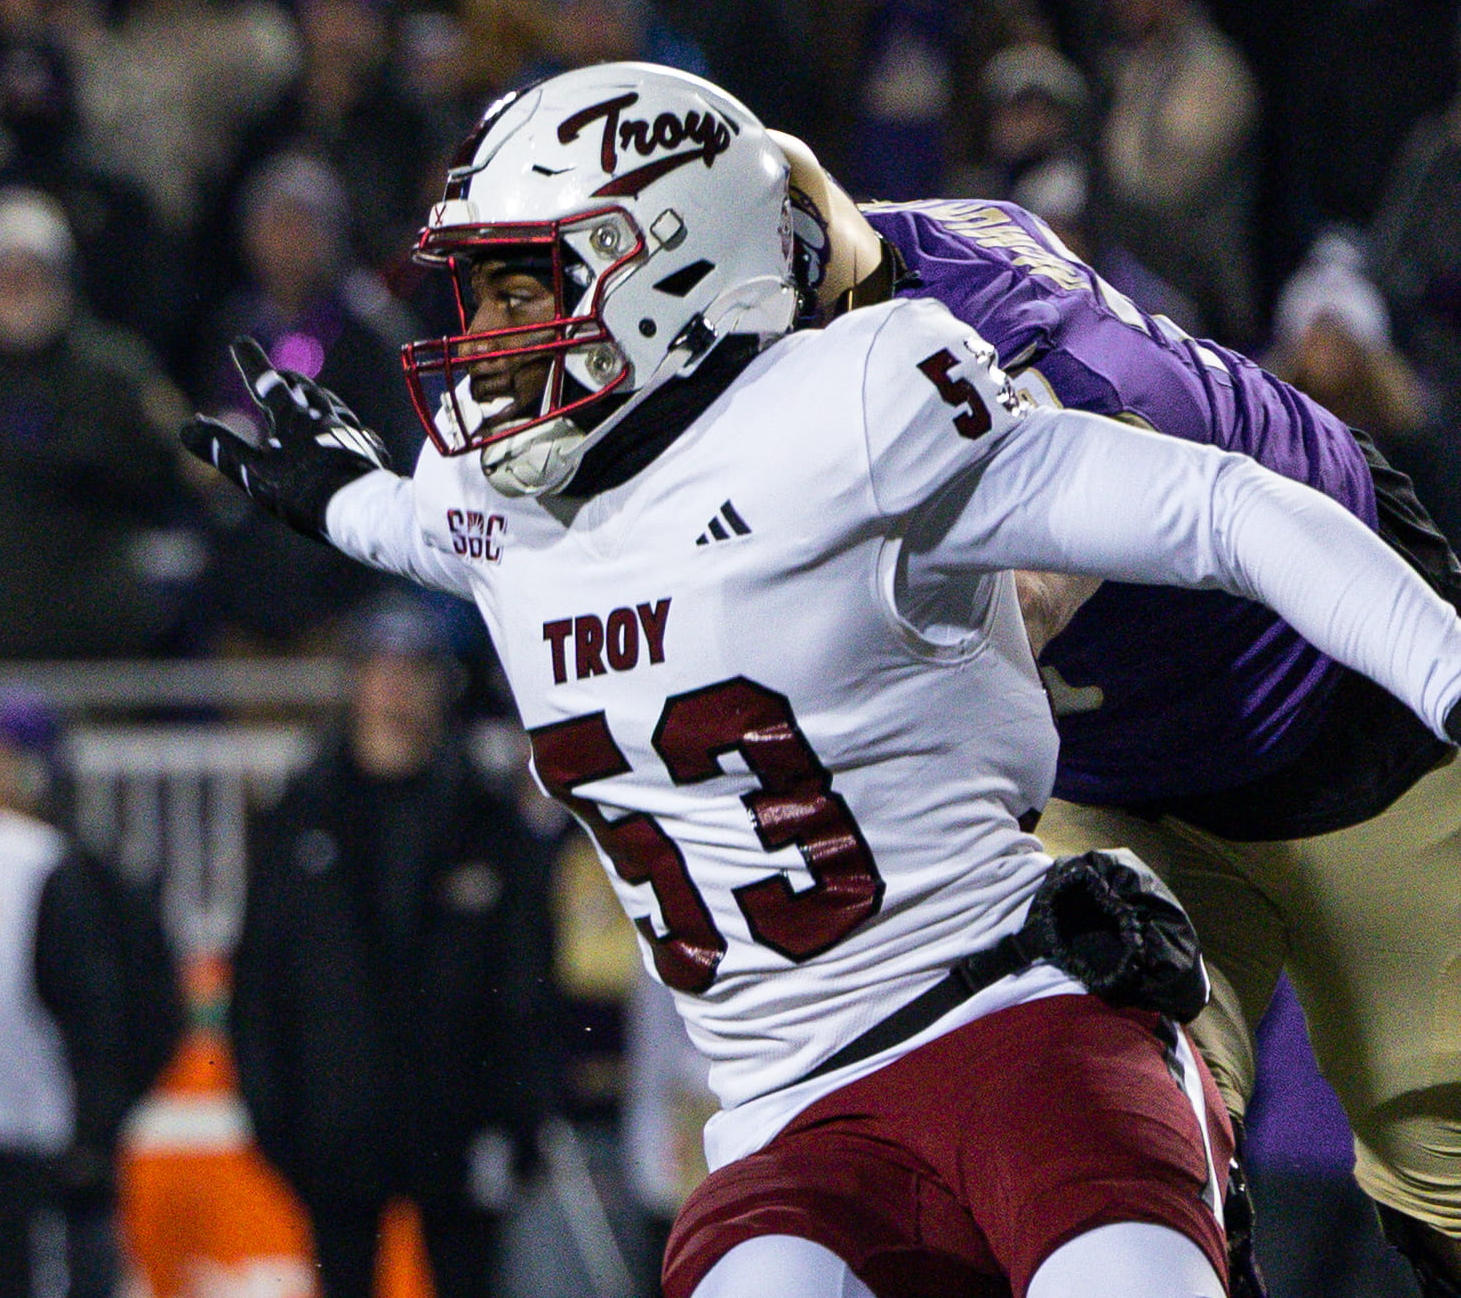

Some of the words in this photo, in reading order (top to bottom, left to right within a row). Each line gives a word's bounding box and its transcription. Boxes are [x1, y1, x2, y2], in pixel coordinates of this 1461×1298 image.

[557, 91, 740, 201] Troy
[916, 333, 1029, 442] 5
[446, 507, 507, 565] SBC
[542, 596, 673, 686] TROY
[525, 674, 887, 997] 53
